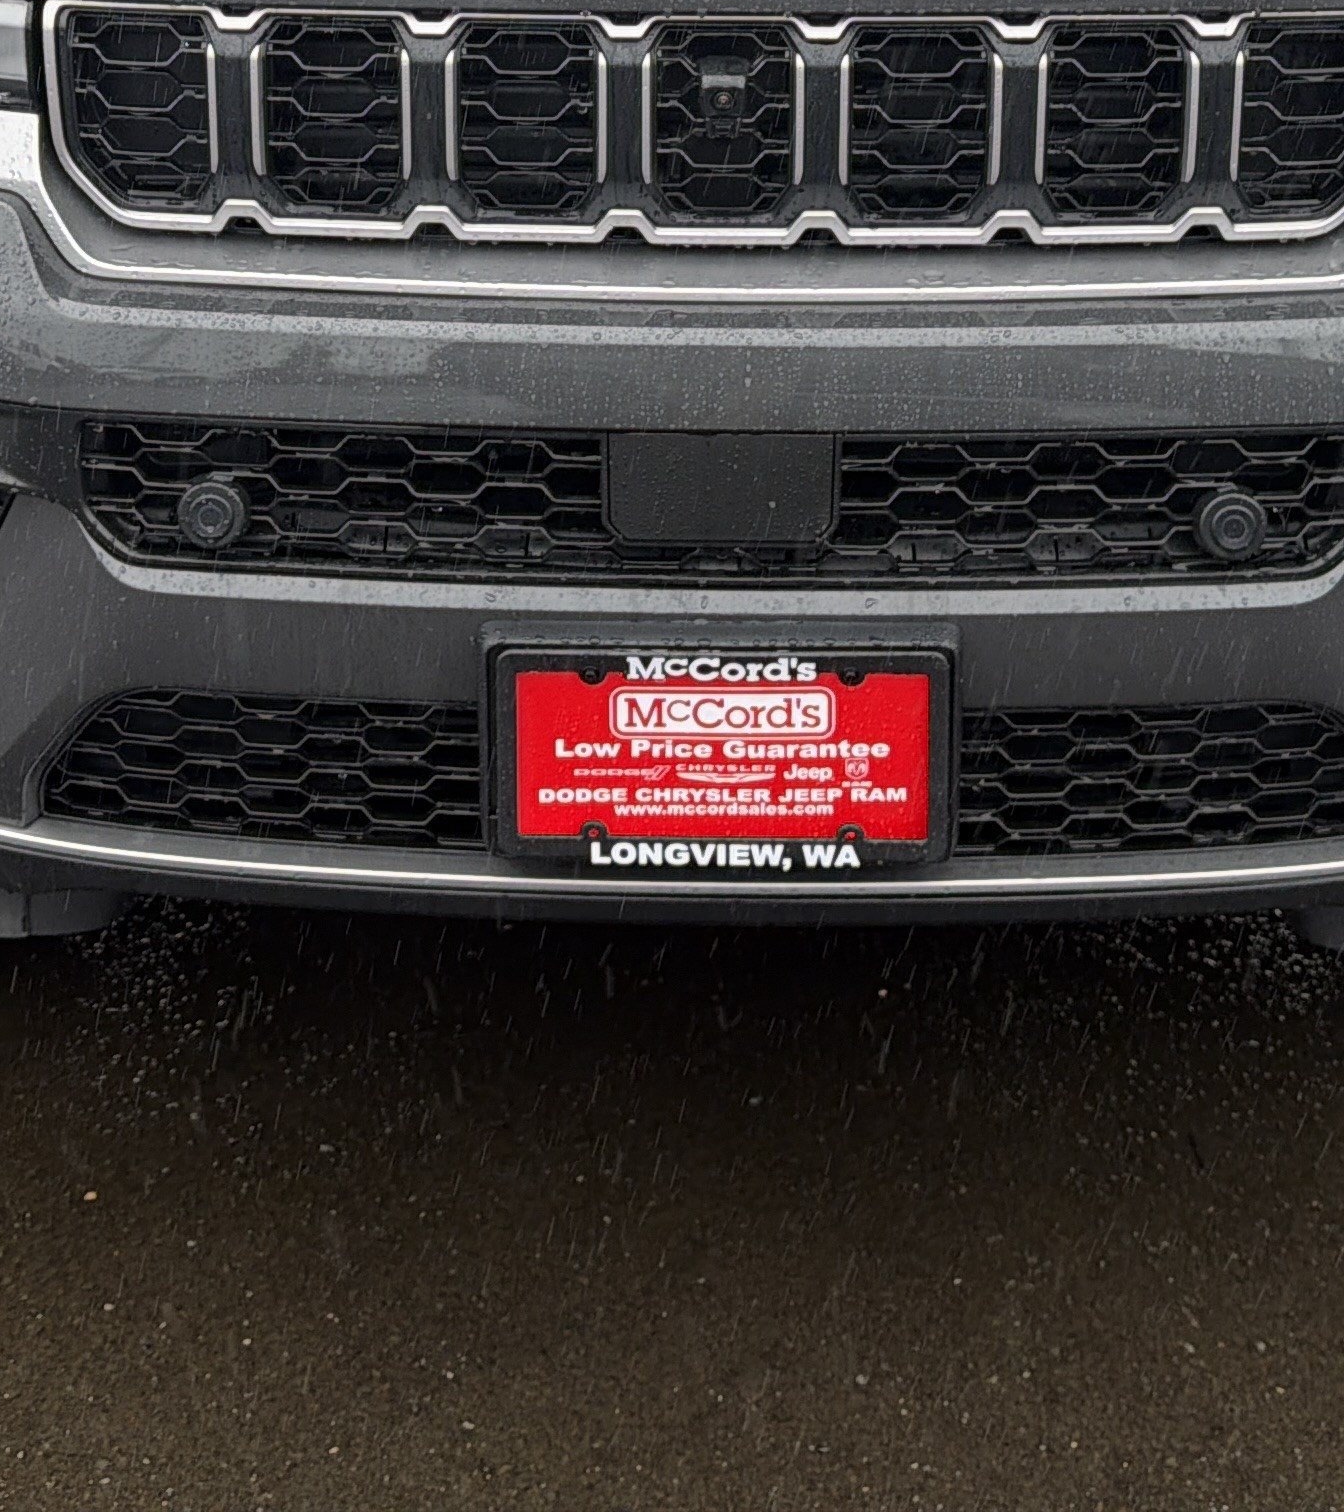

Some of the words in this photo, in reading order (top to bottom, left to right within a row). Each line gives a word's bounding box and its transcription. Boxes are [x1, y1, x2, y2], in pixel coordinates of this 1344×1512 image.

[626, 656, 818, 682] McCord's
[623, 697, 821, 729] McCord's
[554, 739, 621, 758] Low
[630, 739, 713, 758] Price
[722, 739, 891, 759] Guarantee
[675, 763, 777, 772] CHRYSLER
[783, 763, 833, 782] Jeep
[538, 788, 628, 803] DODGE
[635, 788, 771, 803] CHRYSLER
[778, 788, 843, 803] JEEP
[850, 788, 907, 802] RAM
[613, 803, 834, 816] www.mccordsales.com
[590, 842, 792, 871] LONGVIEW,
[802, 844, 861, 868] WA
